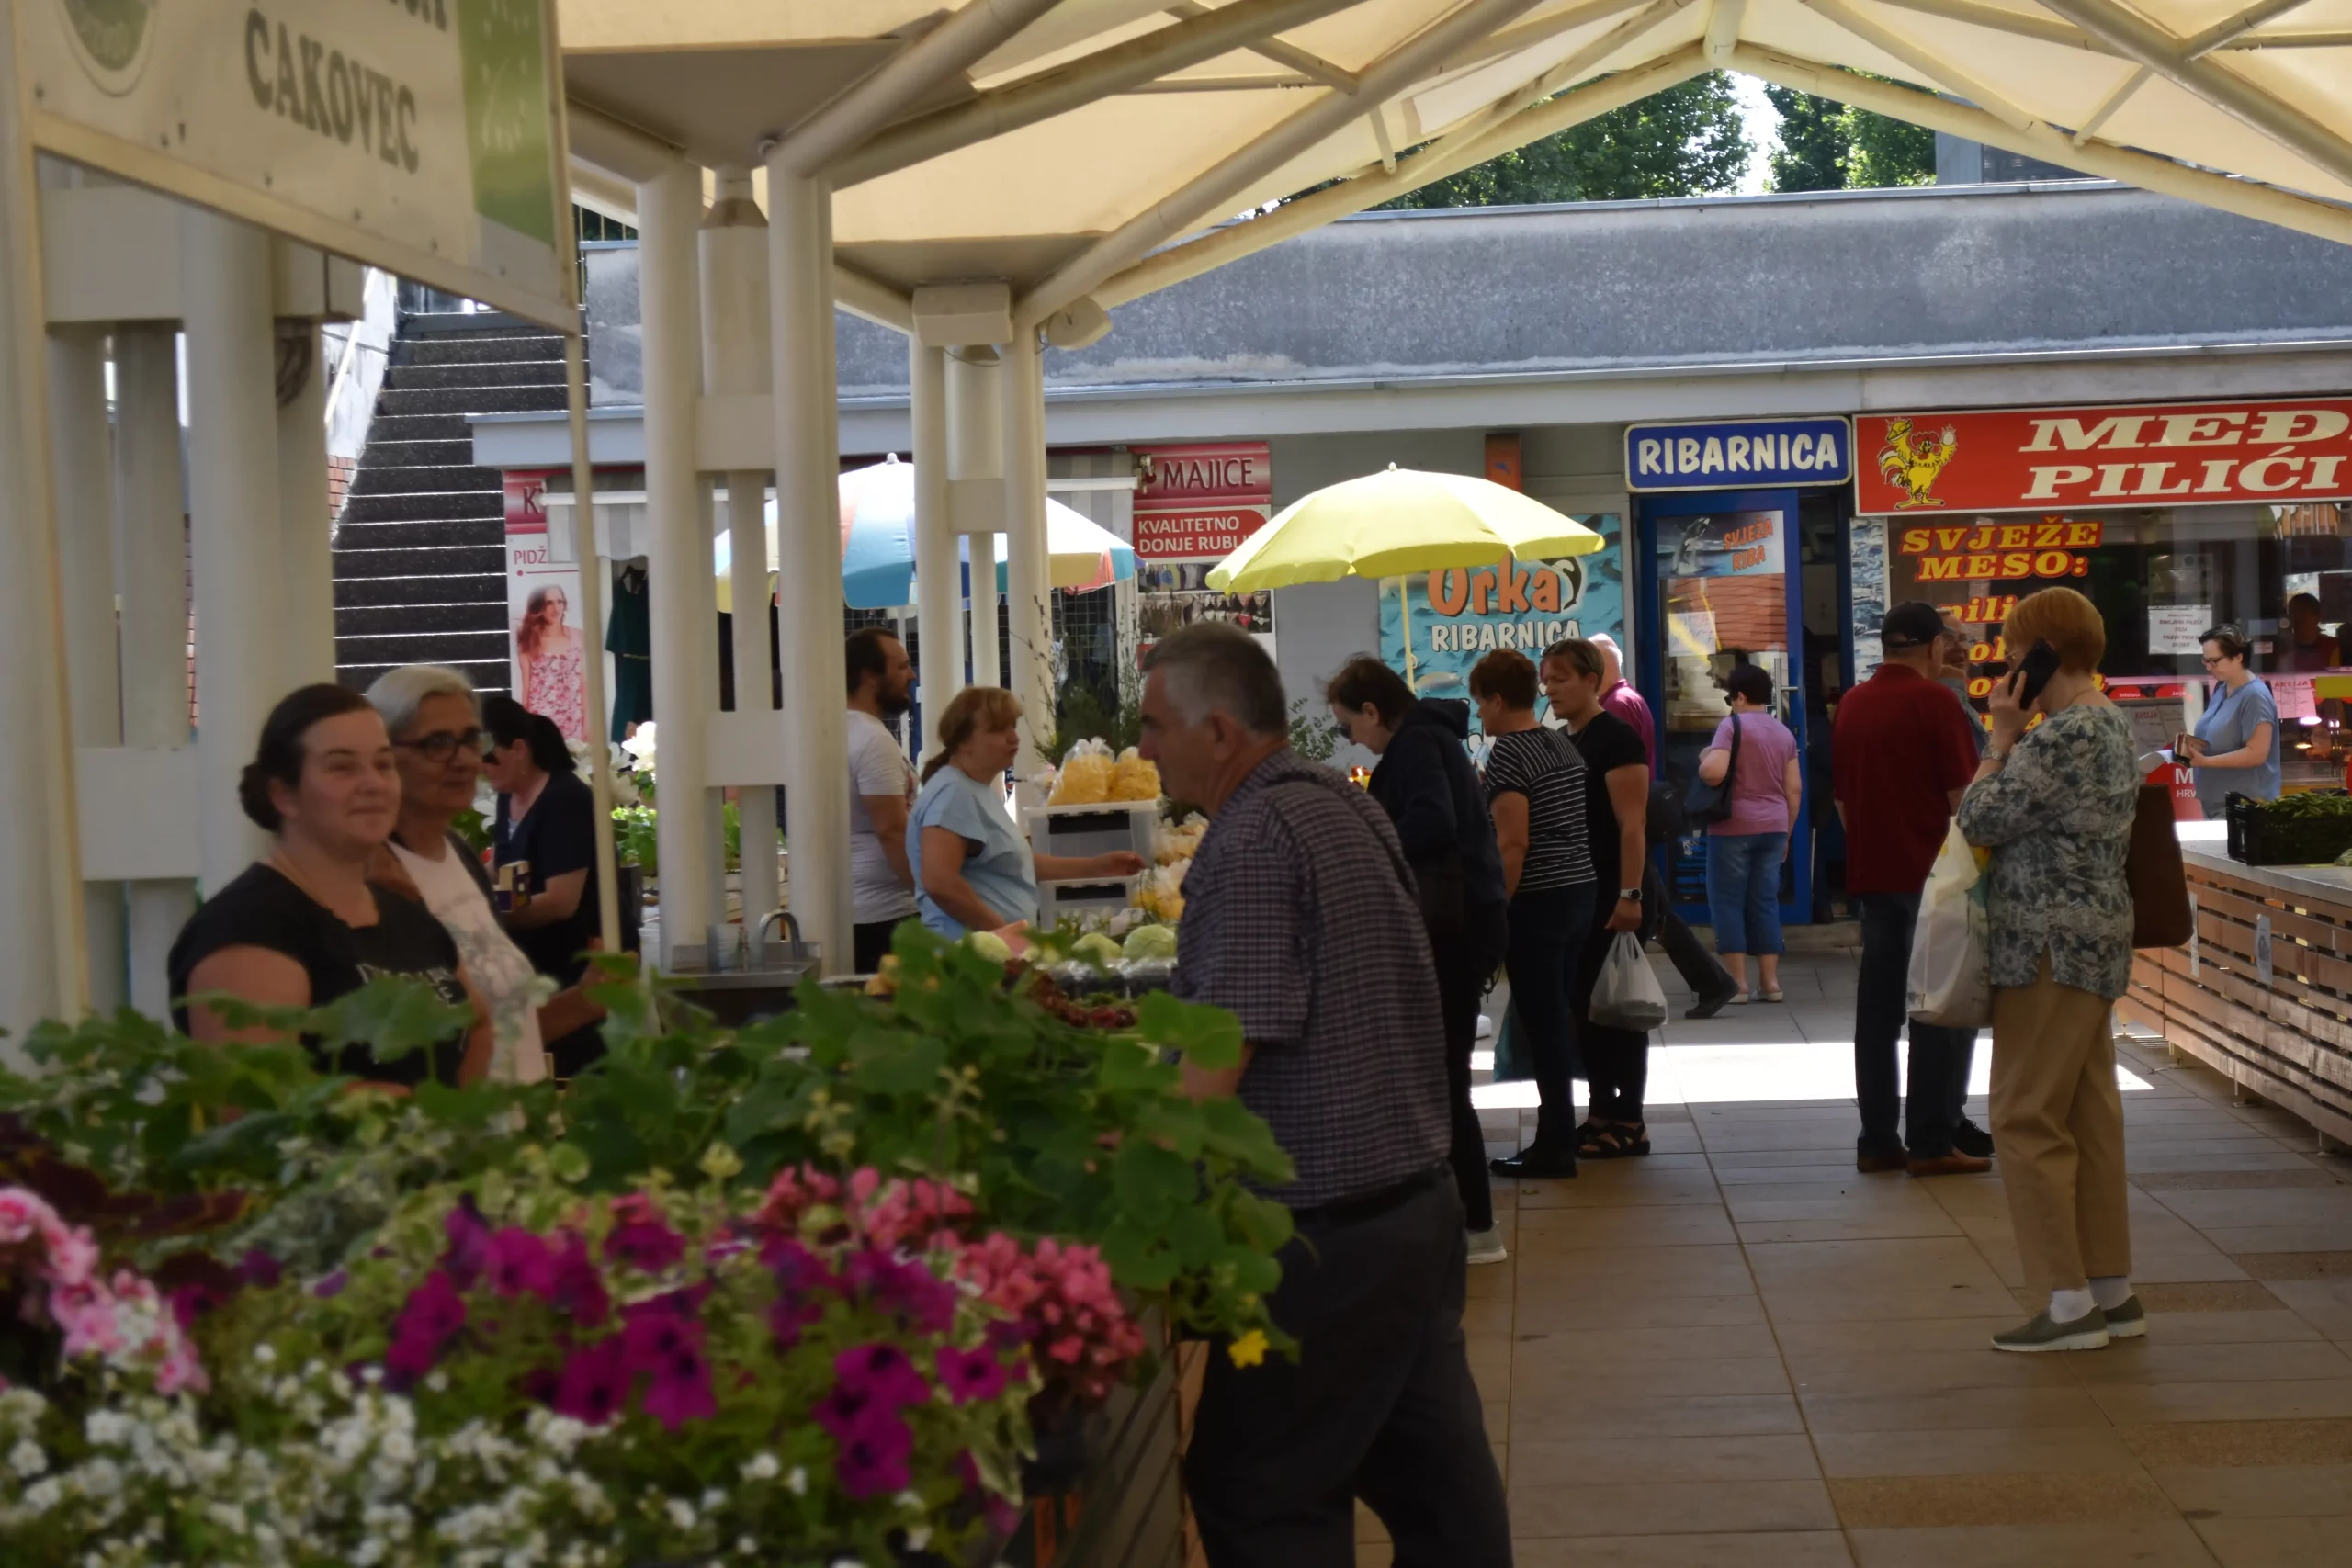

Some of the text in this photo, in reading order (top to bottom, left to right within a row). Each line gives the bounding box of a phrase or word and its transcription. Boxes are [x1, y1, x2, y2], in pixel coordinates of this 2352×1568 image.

[2018, 410, 2352, 452] MEĐ
[1638, 434, 1839, 475] RIBARNICA
[1163, 458, 1255, 491] MAJICE
[2020, 445, 2347, 499] PILIĆI
[1138, 516, 1239, 534] KVALITETNO
[1723, 516, 1773, 550] SVJEŽA
[1902, 515, 2100, 553] SVJEŽE
[514, 546, 547, 565] PIDŽ
[1139, 535, 1249, 553] DONJE RUBL
[1733, 545, 1766, 572] RIBA
[1917, 551, 2086, 581] MESO:
[1428, 551, 1562, 617] Orka
[1431, 620, 1581, 652] RIBARNICA
